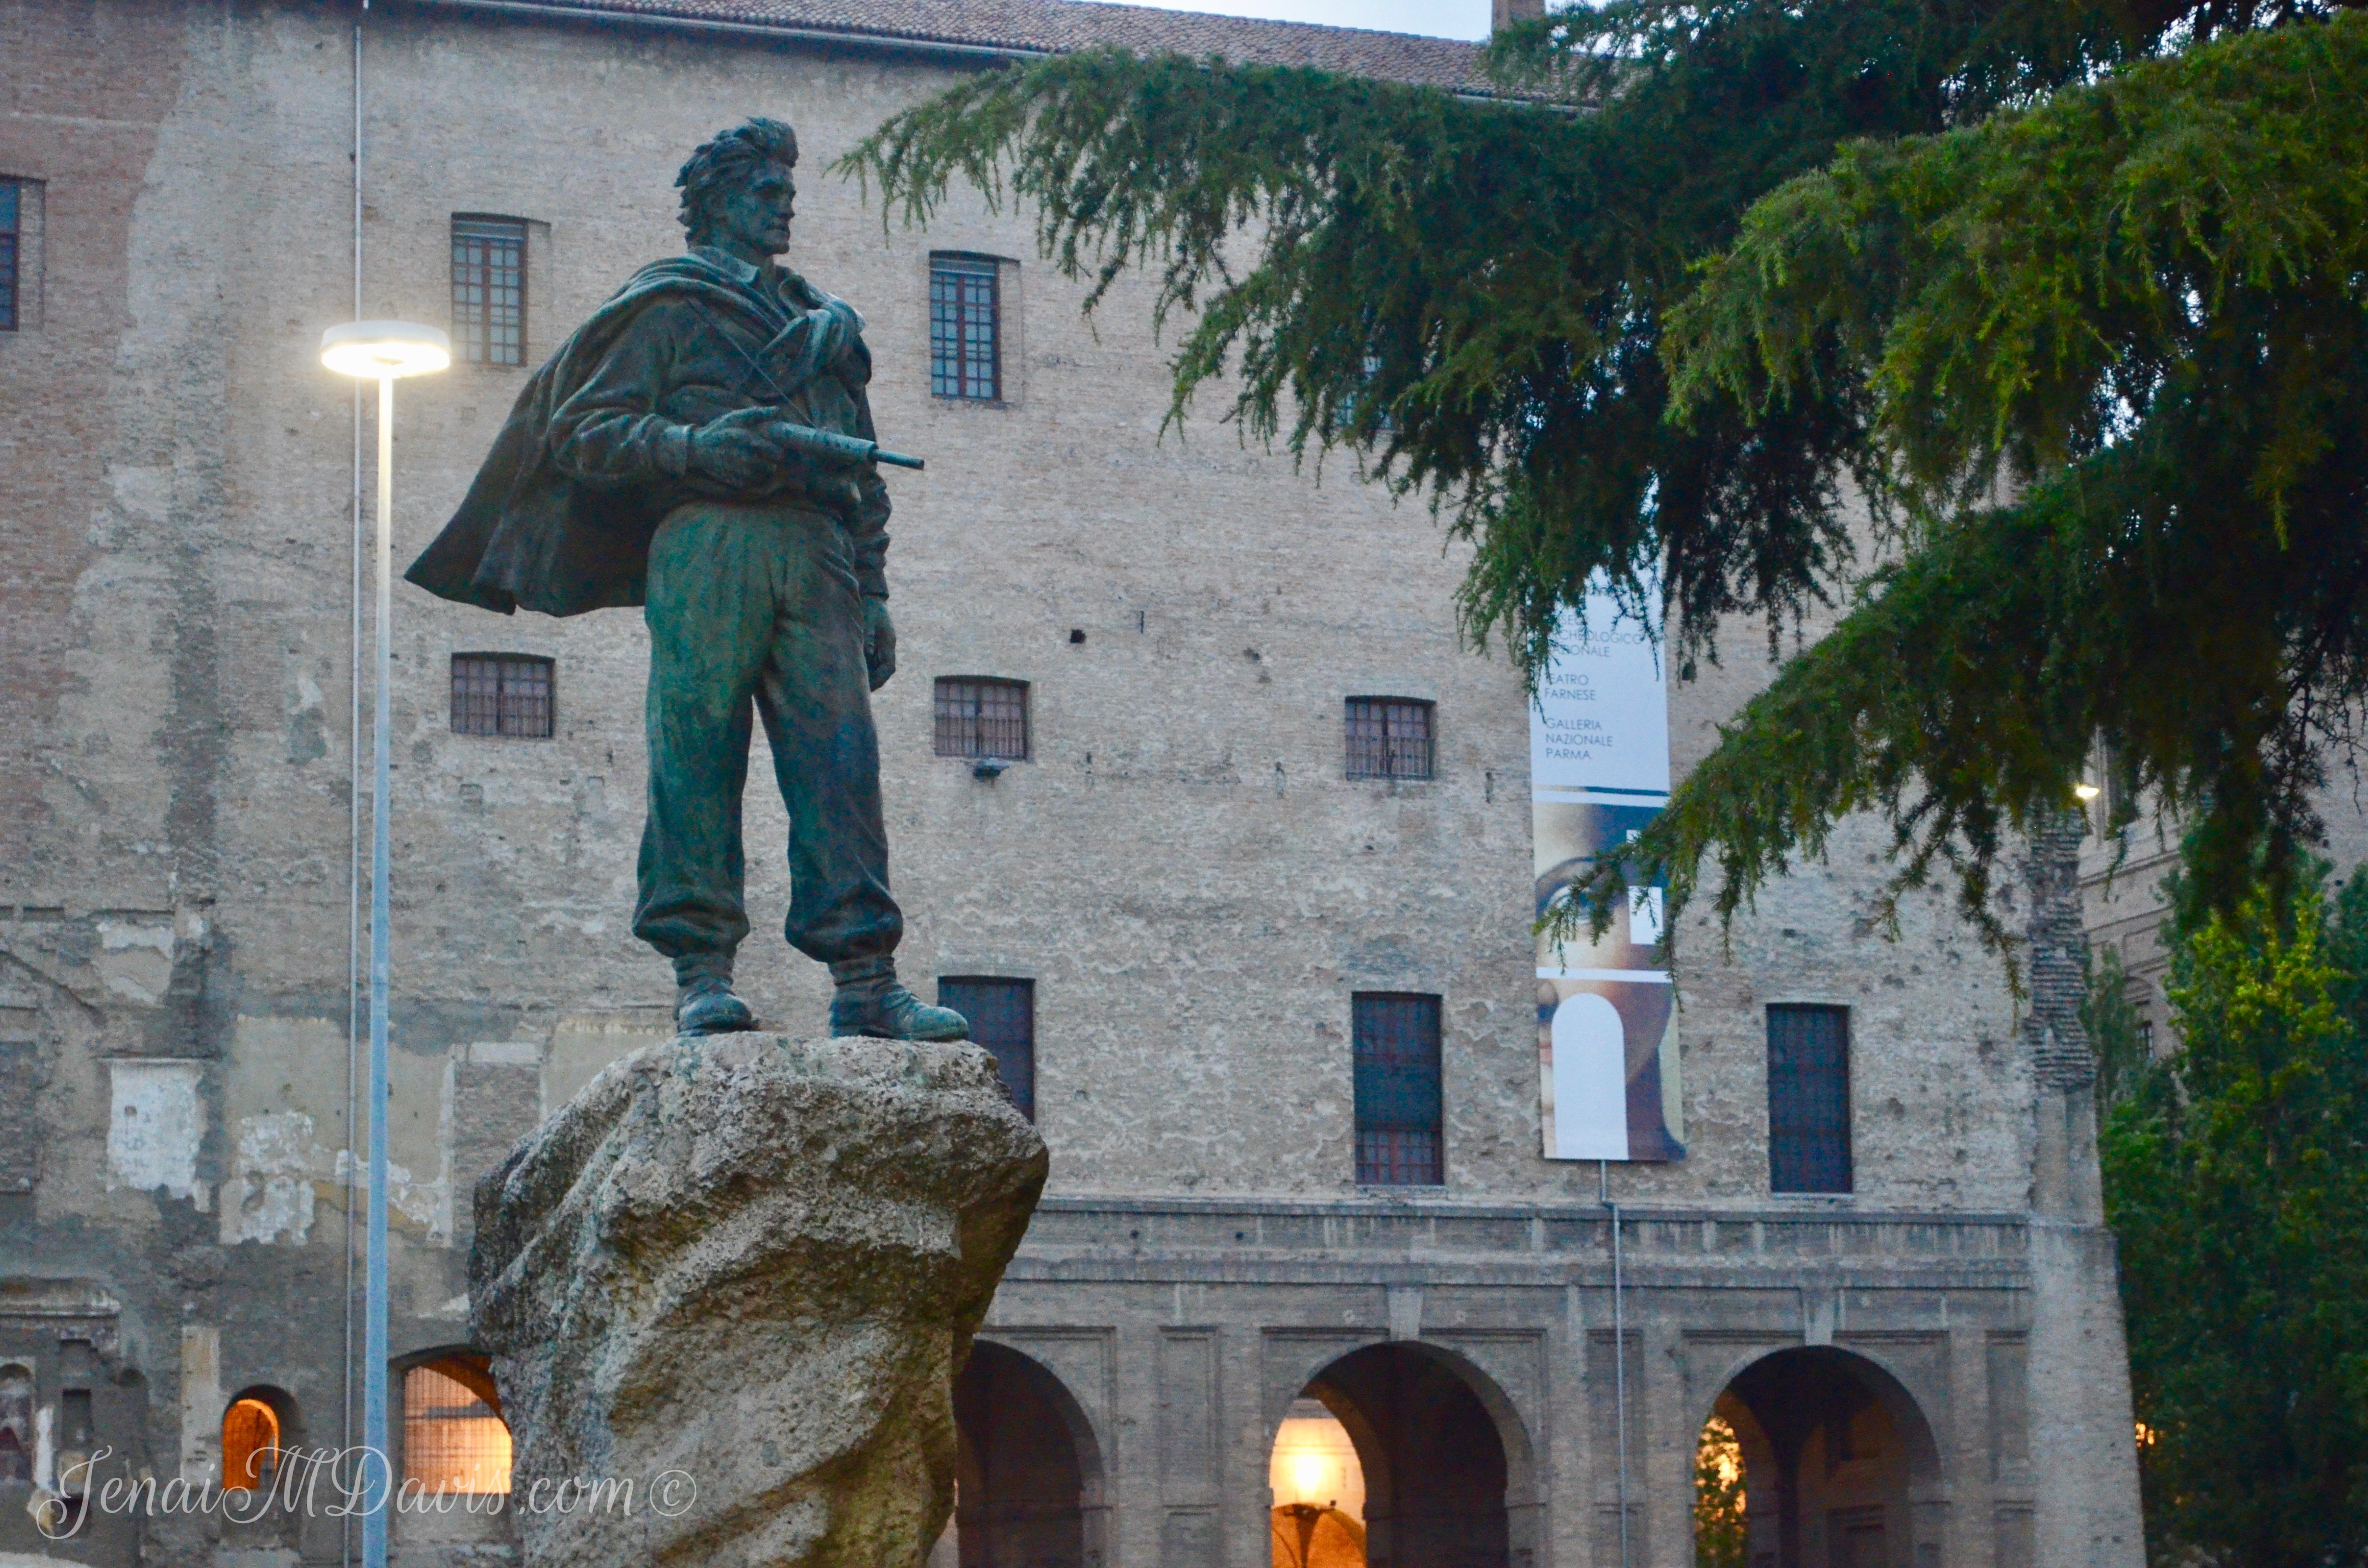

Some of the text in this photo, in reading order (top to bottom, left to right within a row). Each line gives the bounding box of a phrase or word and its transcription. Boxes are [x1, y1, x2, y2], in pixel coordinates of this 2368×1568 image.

[1548, 644, 1610, 657] AZIONALE
[1544, 687, 1596, 700] FARNESE
[1546, 718, 1603, 731] GALLERIA
[1545, 734, 1613, 747] NAZIONALE
[1546, 747, 1591, 760] PARMA
